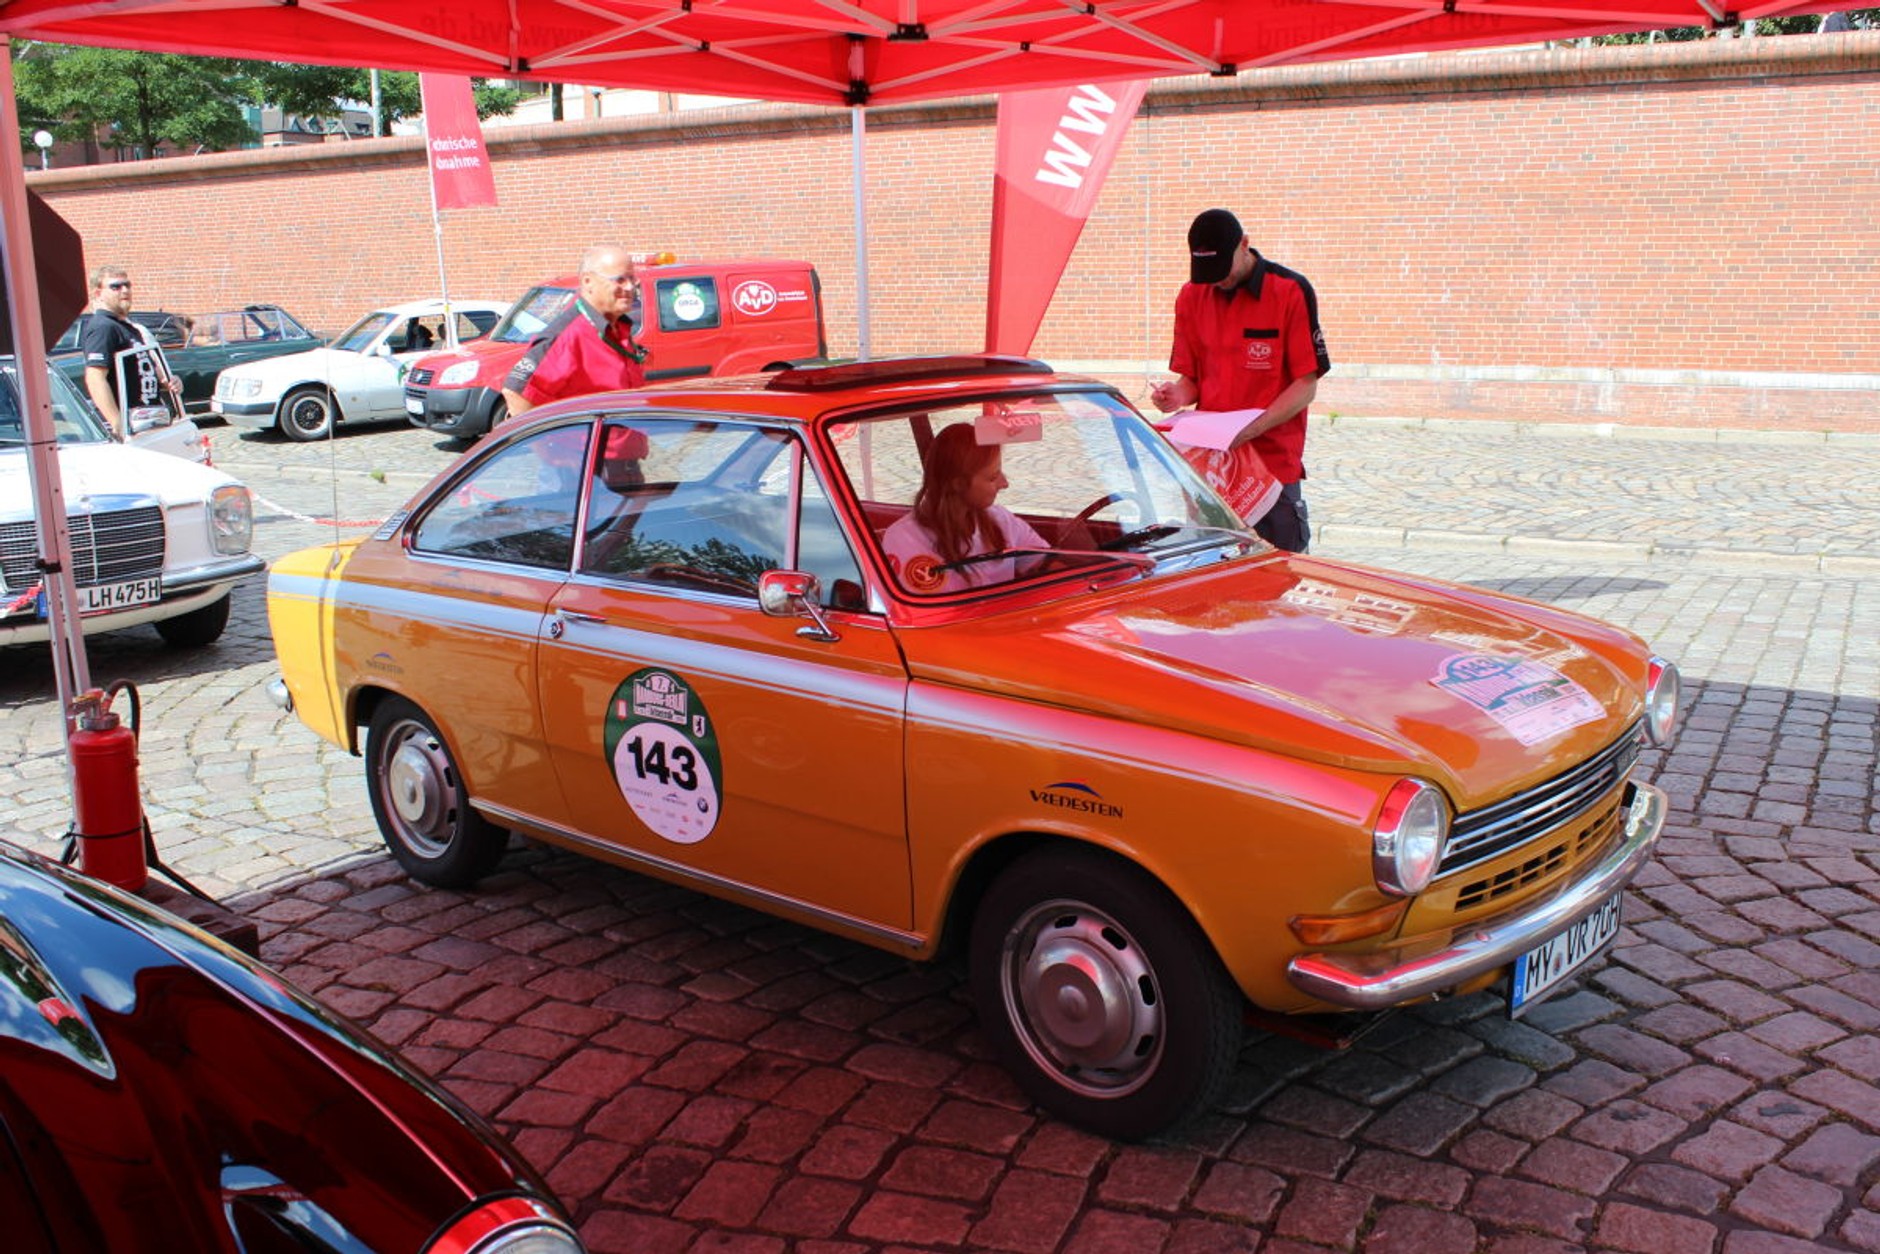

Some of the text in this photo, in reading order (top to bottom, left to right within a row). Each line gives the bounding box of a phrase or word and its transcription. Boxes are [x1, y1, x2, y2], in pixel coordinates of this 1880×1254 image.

[89, 587, 112, 608] LH
[627, 735, 698, 791] 143
[1030, 789, 1123, 818] VREDESTEIN
[1526, 940, 1555, 994] MY
